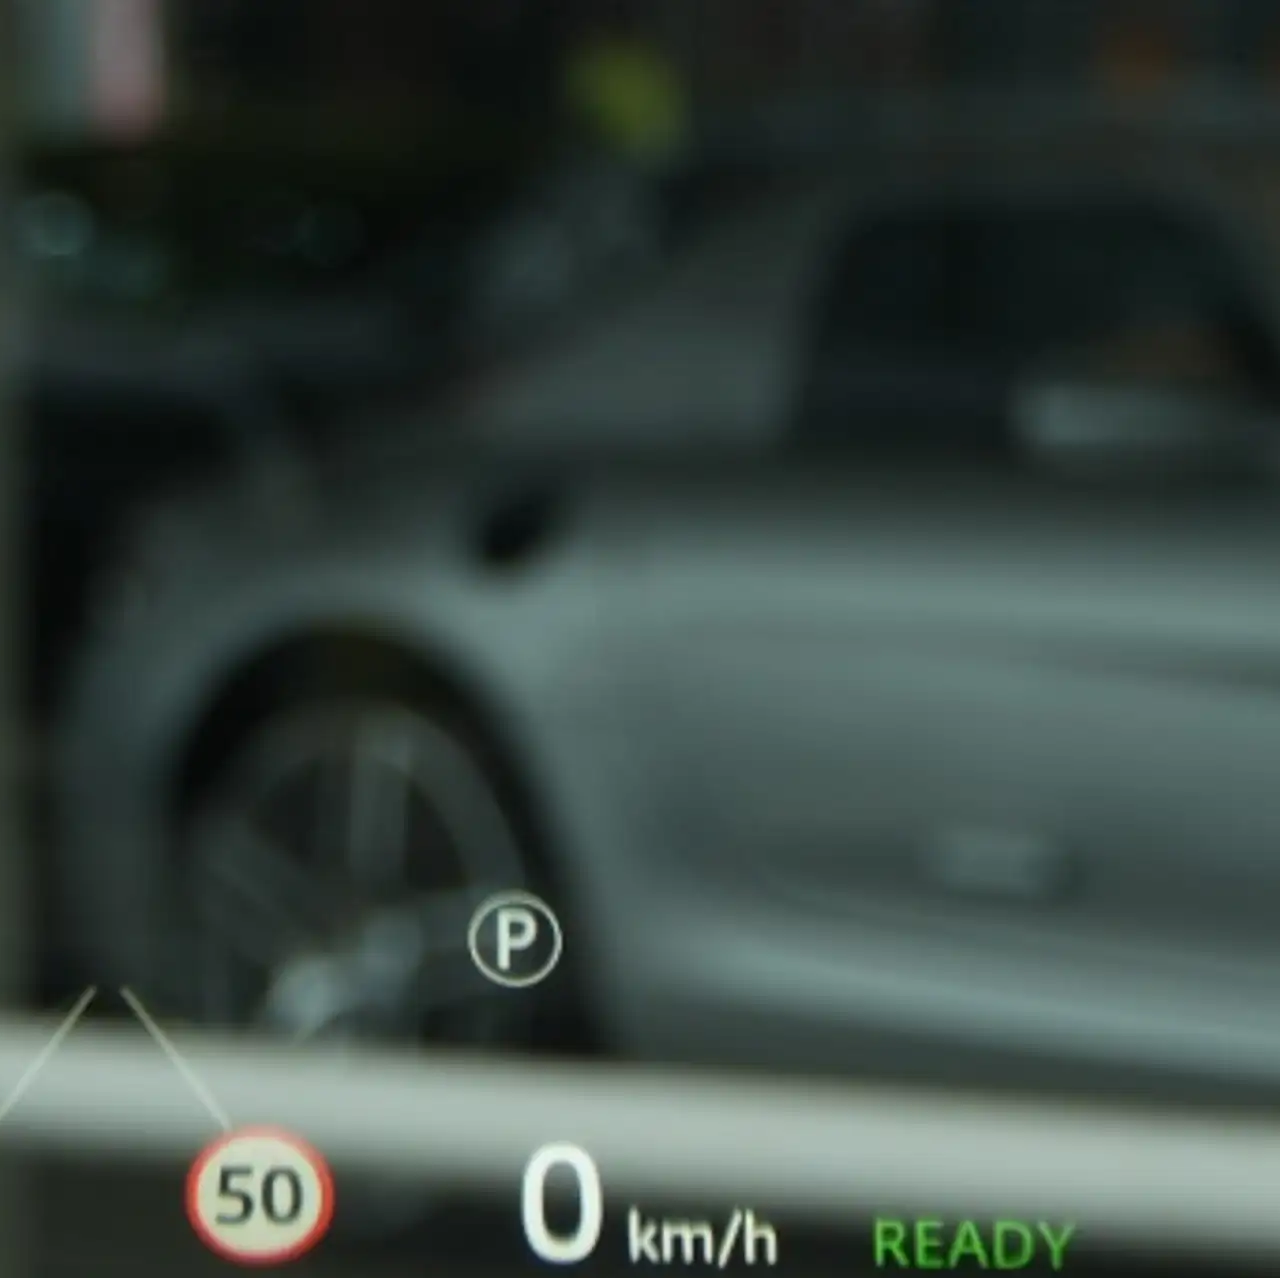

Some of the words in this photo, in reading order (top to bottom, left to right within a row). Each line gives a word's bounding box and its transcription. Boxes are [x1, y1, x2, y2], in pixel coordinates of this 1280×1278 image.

[496, 909, 538, 970] P
[214, 1165, 305, 1226] 50
[521, 1141, 603, 1264] 0
[628, 1209, 778, 1266] km/h
[873, 1218, 1076, 1270] READY
